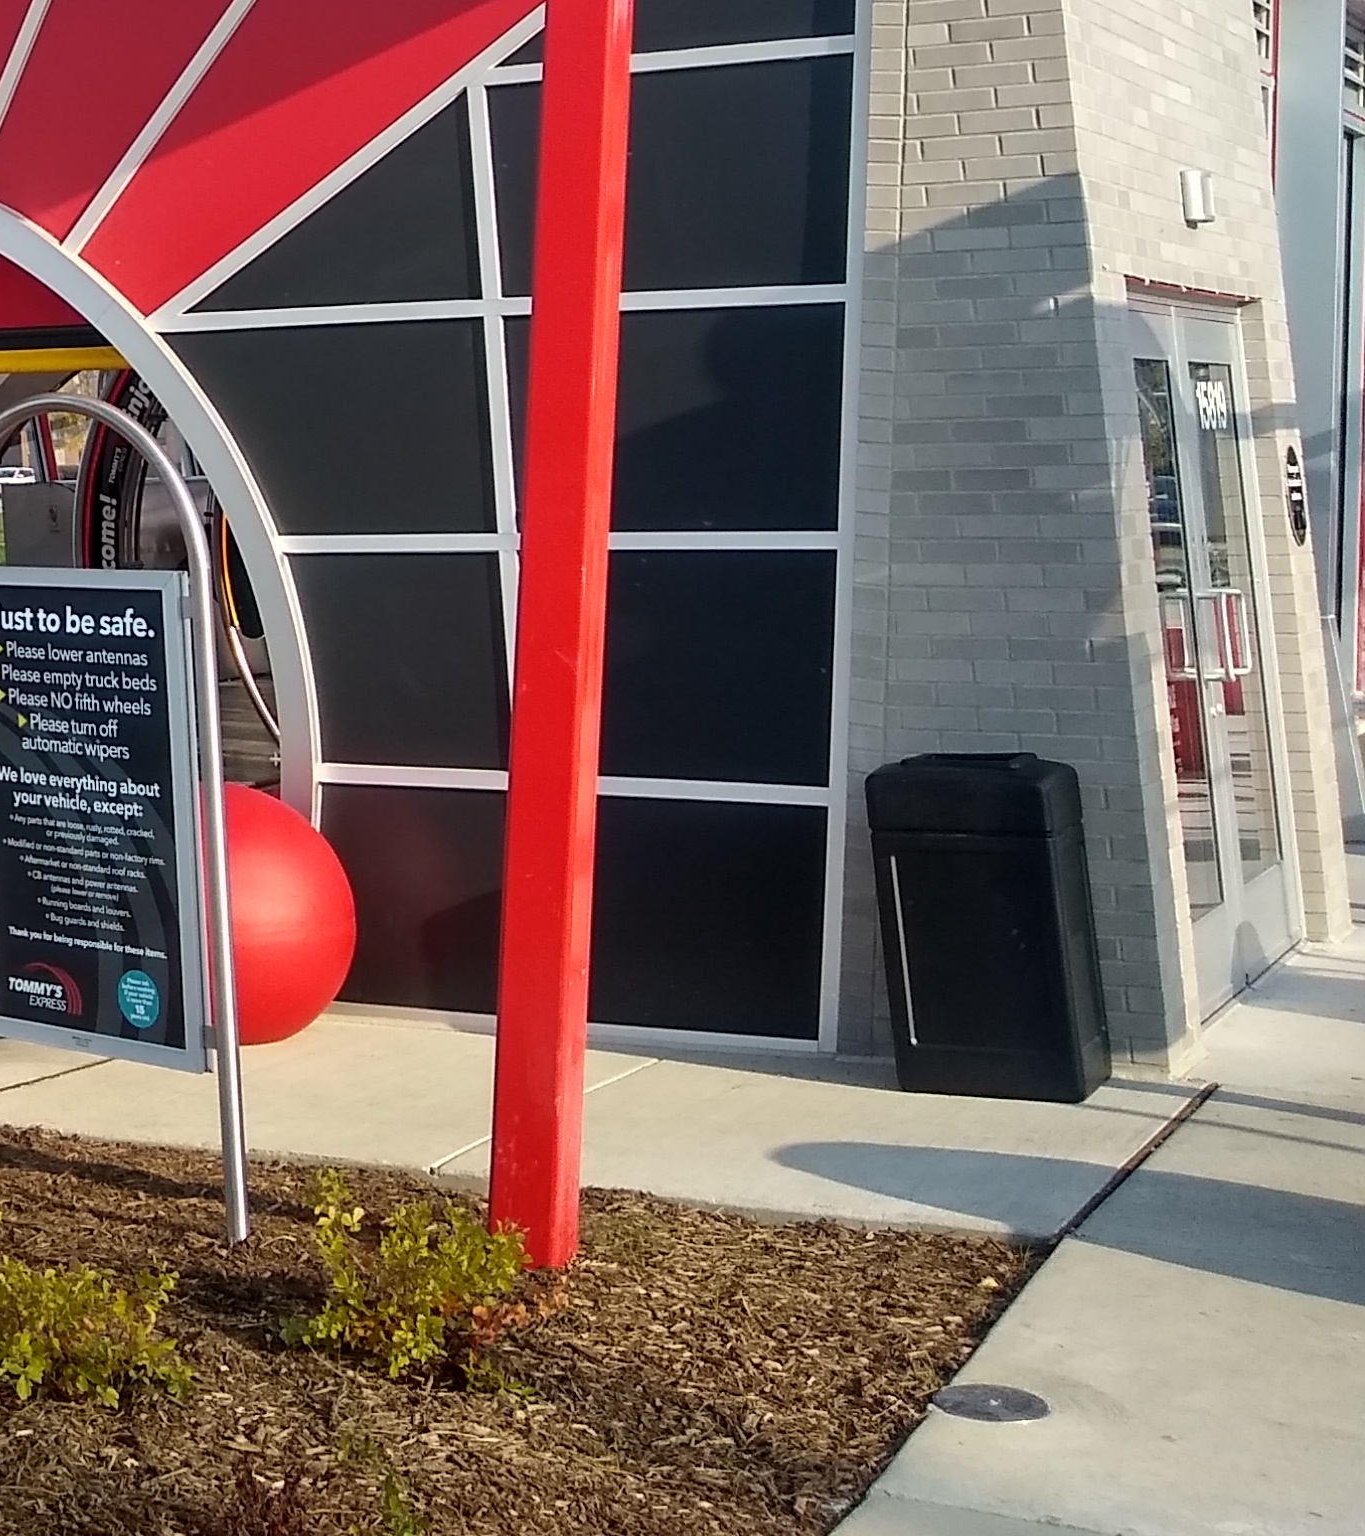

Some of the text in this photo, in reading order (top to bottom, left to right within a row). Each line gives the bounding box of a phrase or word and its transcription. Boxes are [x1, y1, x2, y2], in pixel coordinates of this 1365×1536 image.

[1196, 381, 1227, 430] 15819
[37, 608, 61, 632] to
[66, 605, 95, 634] be
[99, 608, 155, 638] safe.
[6, 641, 148, 666] Please lower antennas
[1, 664, 157, 691] Please empty truck beds
[8, 688, 151, 715] Please NO fifth wheels
[30, 713, 118, 737] Please turn off
[22, 736, 130, 762] automatic wipers
[20, 767, 47, 785] love
[49, 774, 117, 797] everything
[120, 778, 160, 798] about
[13, 791, 143, 820] your vehicle, except:
[8, 977, 63, 998] TOMMY'S
[29, 996, 67, 1011] EXPRESS
[135, 1005, 145, 1015] 15
